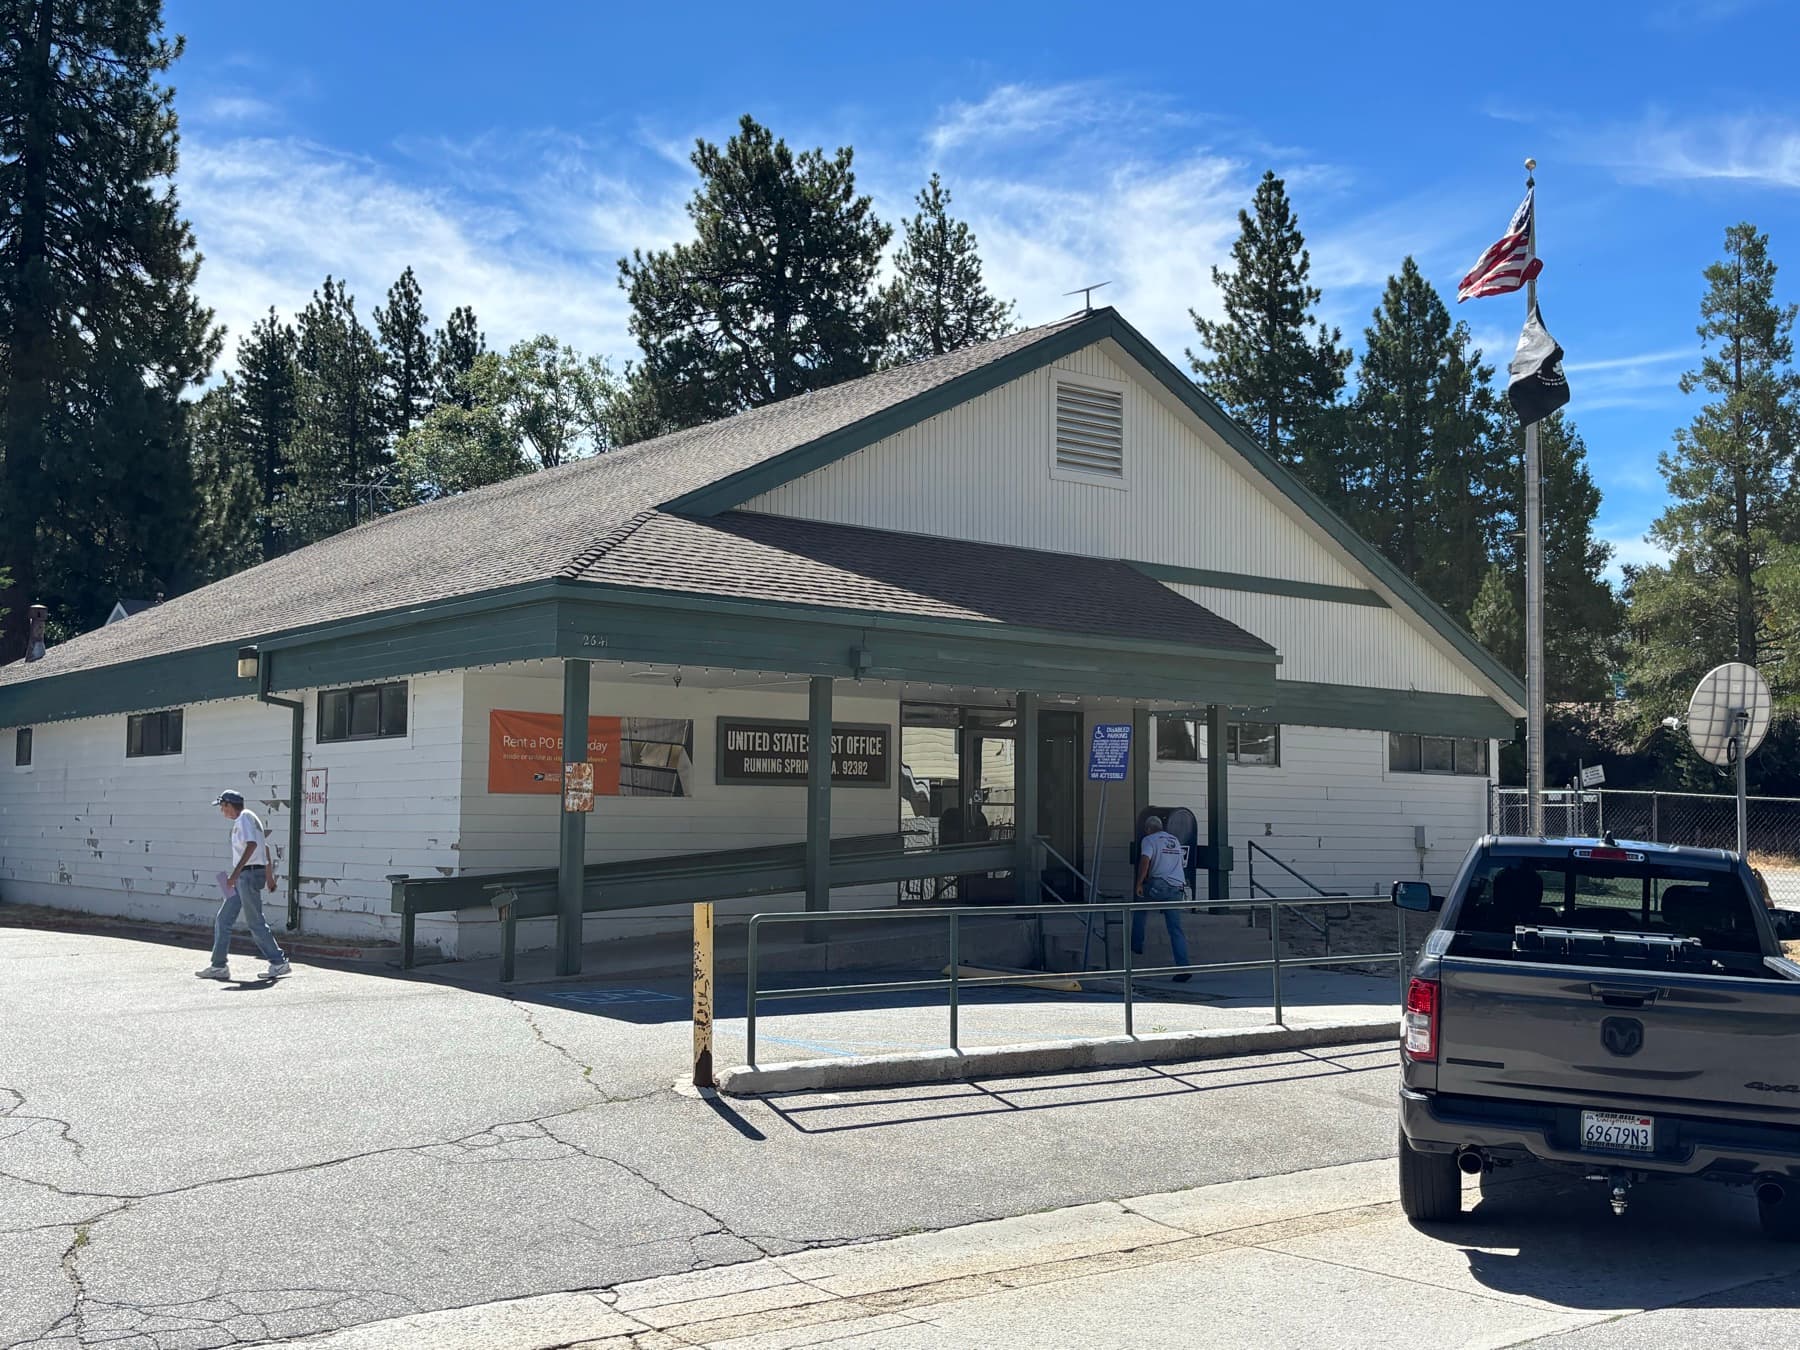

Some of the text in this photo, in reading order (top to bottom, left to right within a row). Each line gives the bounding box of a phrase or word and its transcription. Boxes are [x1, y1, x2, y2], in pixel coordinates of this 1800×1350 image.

[503, 735, 528, 749] Rent
[530, 740, 536, 749] a
[539, 737, 555, 750] PO
[727, 730, 770, 752] UNITED
[830, 735, 844, 754] ST
[846, 736, 882, 755] OFFICE
[743, 757, 868, 776] RUNNING SPRIN A. 92382
[311, 775, 320, 788] NO
[306, 791, 325, 804] PARKING
[310, 807, 319, 816] ANY
[310, 819, 319, 828] TIME
[1586, 1124, 1649, 1146] 69679N3
